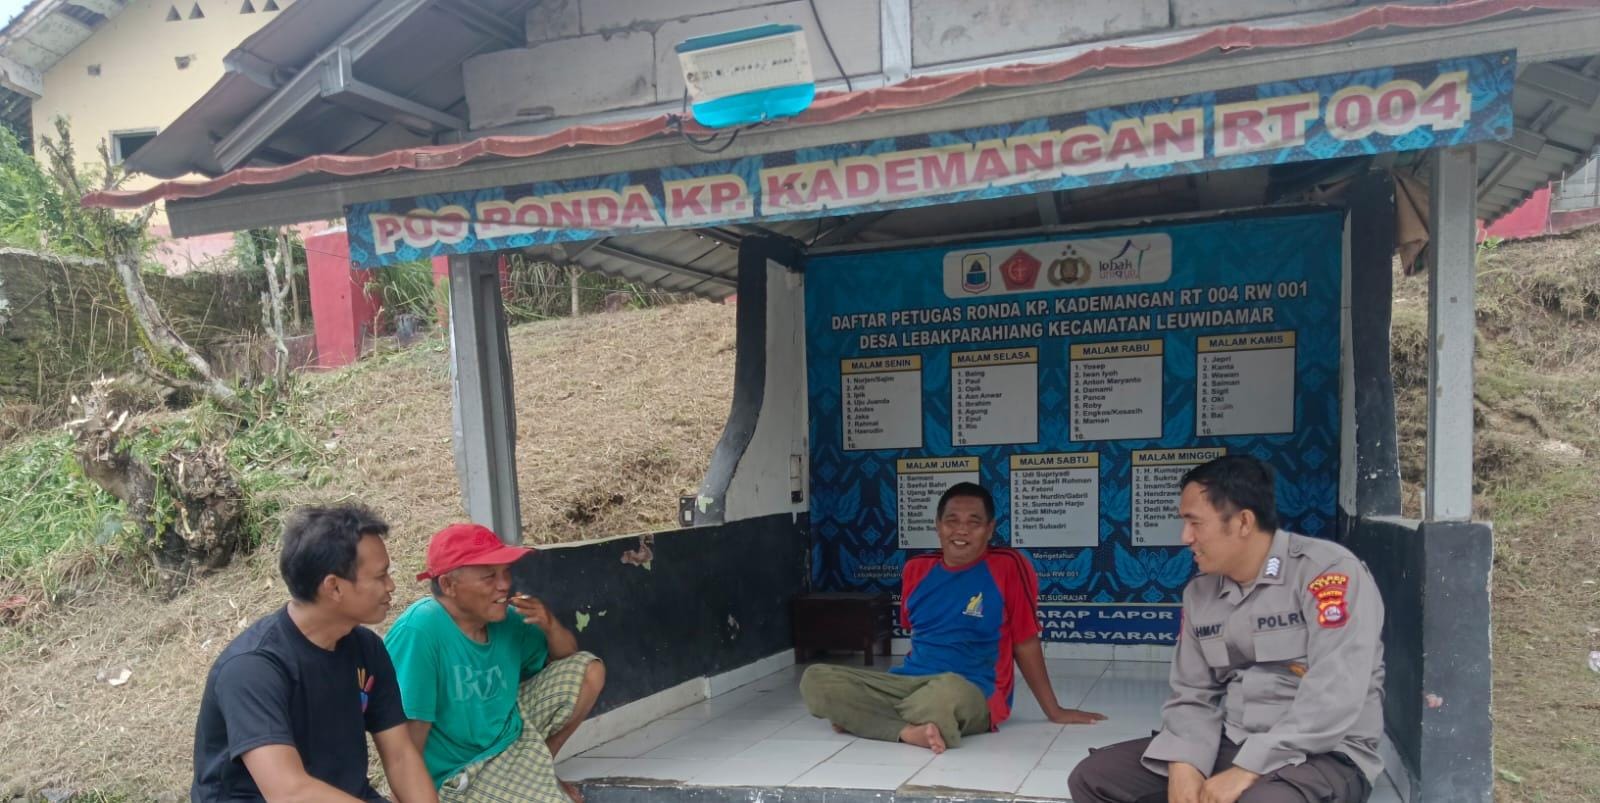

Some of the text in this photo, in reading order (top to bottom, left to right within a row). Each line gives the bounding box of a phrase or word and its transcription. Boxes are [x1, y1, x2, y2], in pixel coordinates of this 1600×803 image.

[376, 80, 1461, 252] POS RONDA KP. KADEMANGAN RT 004
[832, 281, 1308, 330] DAFTAR PETUGAS RONDA KP. KADEMANGAN RT 004 RW 001
[860, 307, 1274, 350] DESA LEBAKPARAHIANG KECAMATAN LEUWIDAMAR
[1210, 336, 1283, 347] MALAM KAMIS
[1083, 344, 1149, 355] MALAM RABU
[958, 352, 1030, 363] MALAM SELASA
[852, 361, 882, 369] MALAM
[1056, 456, 1089, 464] SABTU
[1139, 452, 1219, 462] MALAM MINGGU
[1036, 610, 1174, 619] ARAP LAPOR
[1051, 631, 1177, 640] MASYARAK
